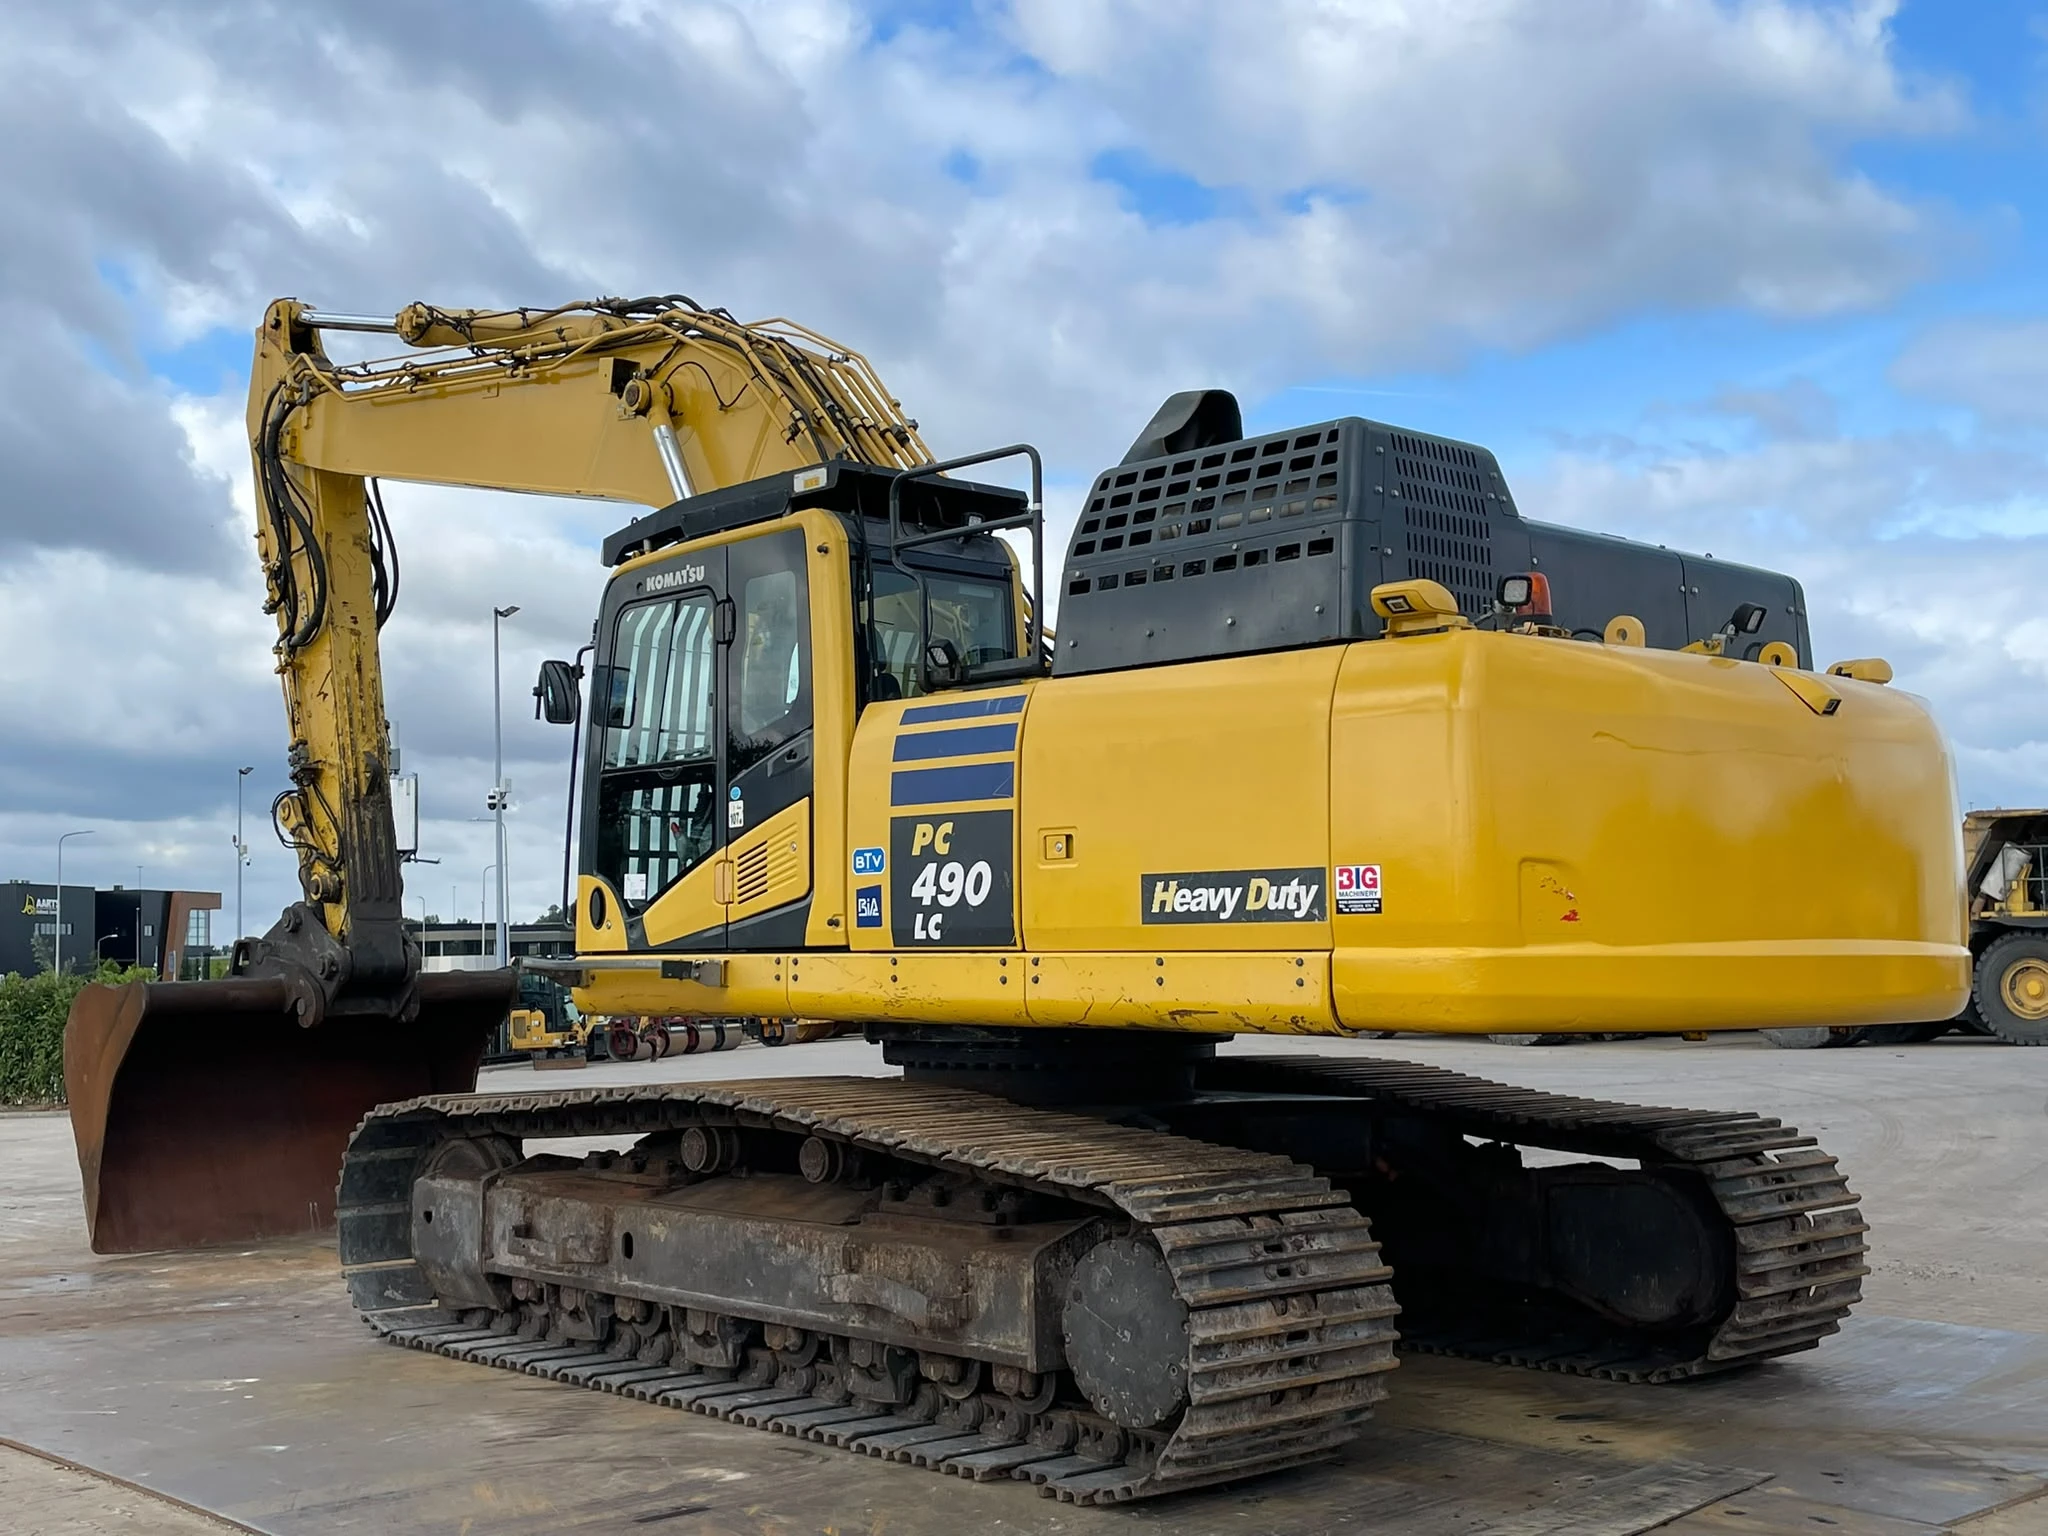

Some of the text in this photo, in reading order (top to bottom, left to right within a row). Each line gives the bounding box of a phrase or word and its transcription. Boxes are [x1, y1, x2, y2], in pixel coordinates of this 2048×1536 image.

[646, 564, 705, 592] KOMATSU
[911, 821, 954, 856] PC
[855, 852, 882, 870] BTV
[911, 860, 992, 907] 490
[1338, 866, 1378, 890] BIG
[1151, 877, 1319, 920] Heavy Duty
[914, 913, 943, 940] LC
